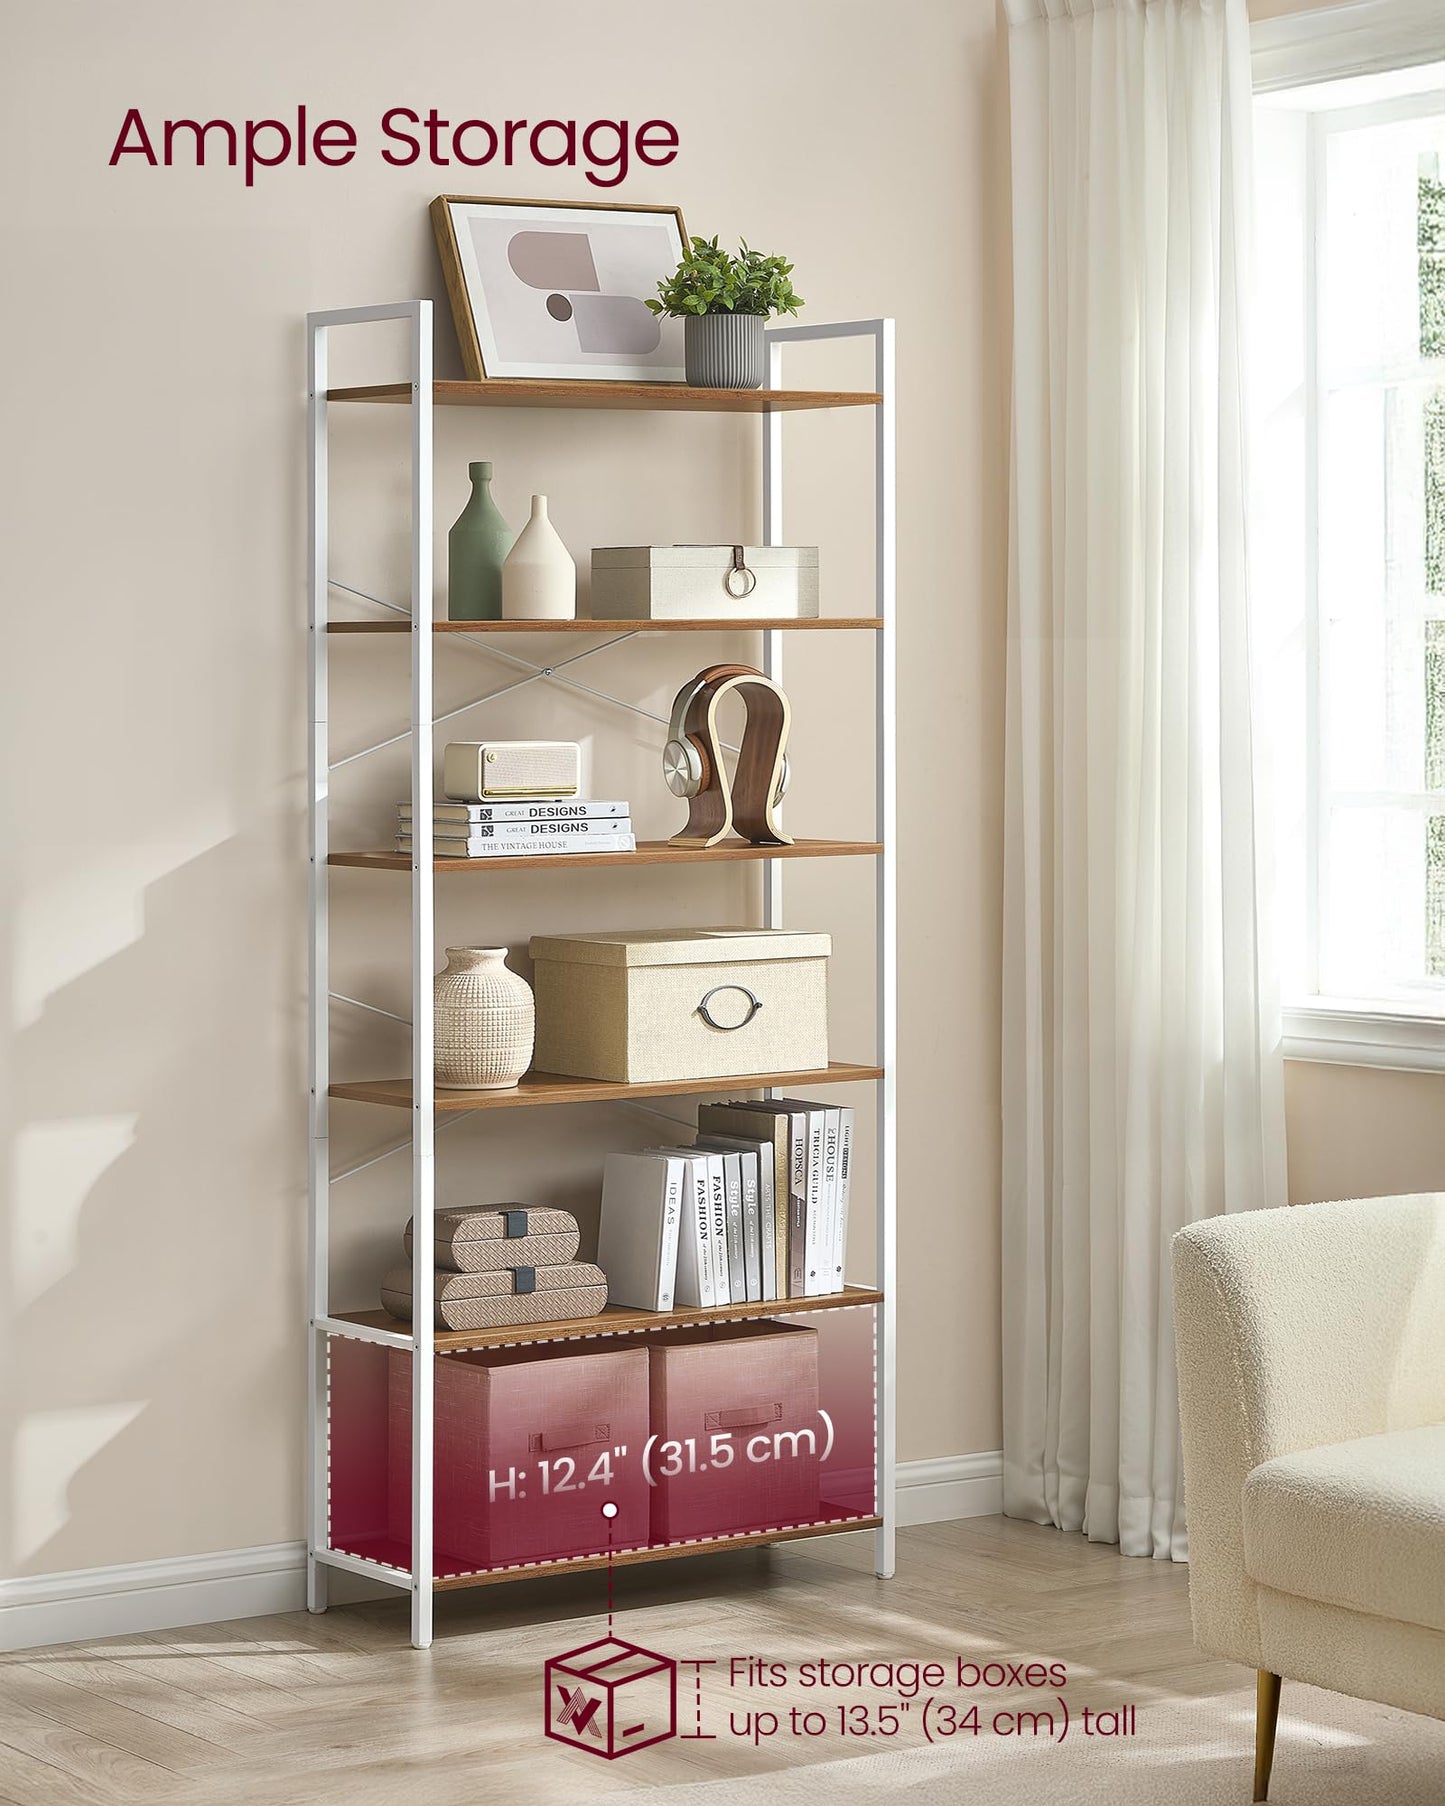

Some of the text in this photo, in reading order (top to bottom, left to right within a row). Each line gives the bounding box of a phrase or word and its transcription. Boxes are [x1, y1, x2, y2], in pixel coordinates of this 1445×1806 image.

[529, 806, 587, 818] DESIGNS
[530, 823, 589, 834] DESIGNS
[482, 841, 568, 851] THE VINTAGE HOUSE
[794, 1138, 804, 1186] HOPSCA
[812, 1128, 821, 1167] TRICIA
[667, 1182, 678, 1225] IDEAS
[728, 1181, 739, 1216] Style
[745, 1180, 756, 1215] Style
[811, 1169, 819, 1205] GUILD
[697, 1180, 708, 1240] FASHION
[713, 1176, 724, 1236] FASHION
